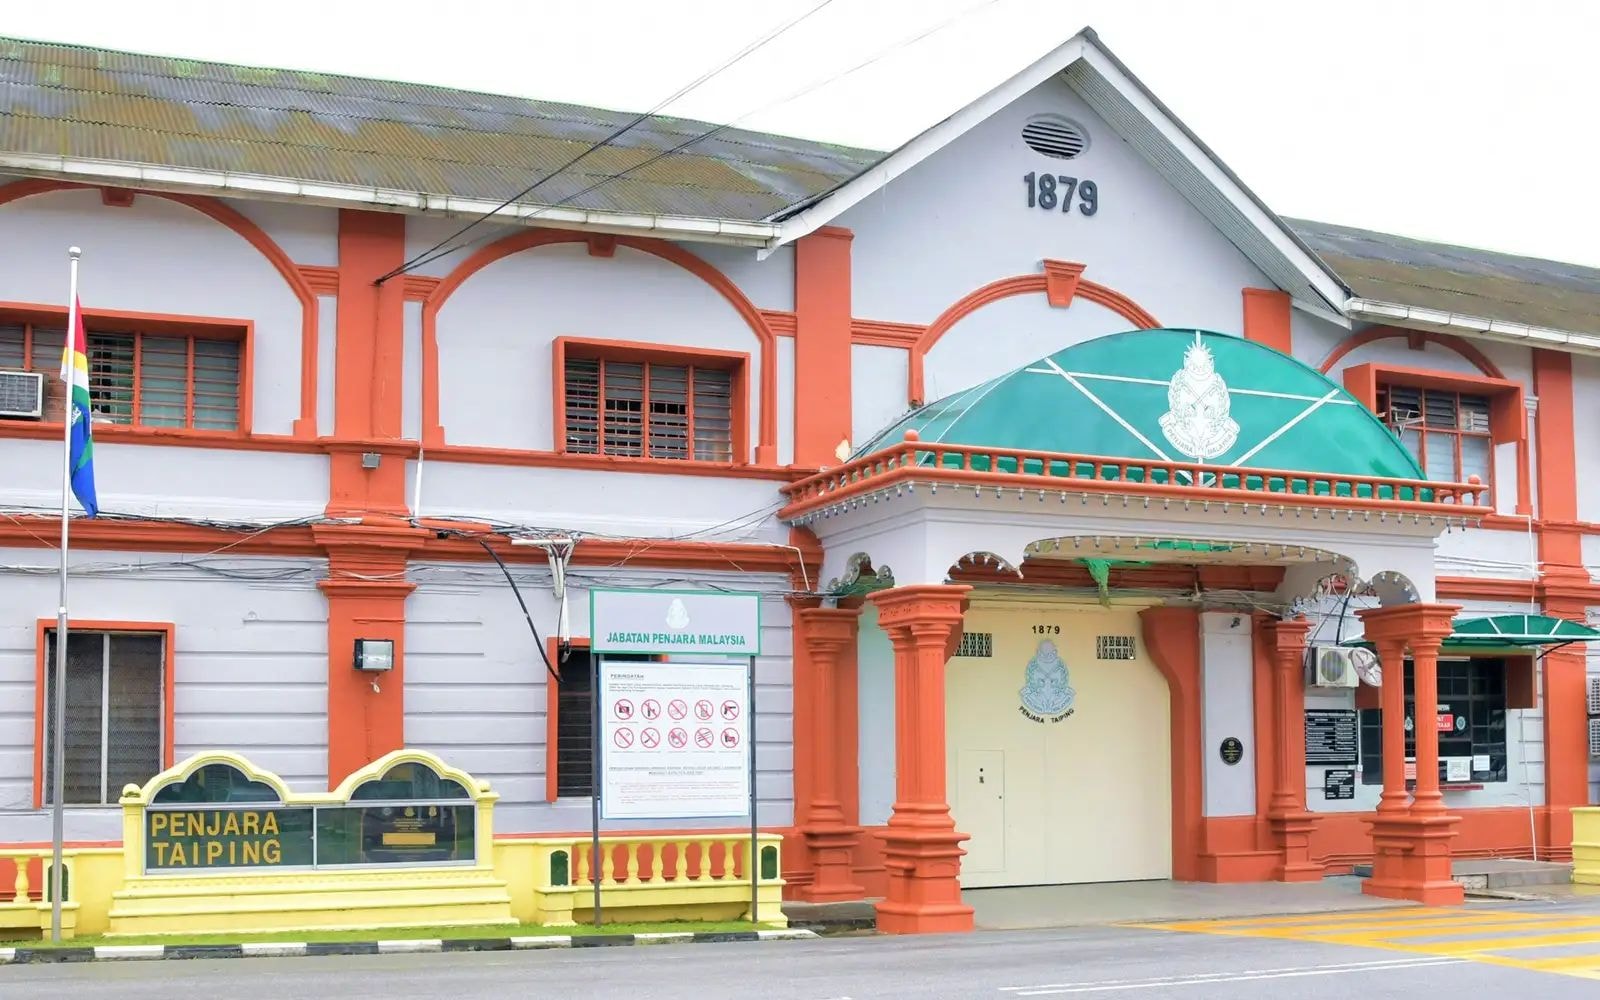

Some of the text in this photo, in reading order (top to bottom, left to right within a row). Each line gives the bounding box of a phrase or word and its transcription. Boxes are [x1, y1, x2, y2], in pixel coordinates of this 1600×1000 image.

[1024, 171, 1098, 217] 1879
[607, 632, 746, 646] JABATAN PENJARA MALAYSIA
[1032, 625, 1060, 635] 1879
[1019, 706, 1075, 724] PENJARA TAIPING
[151, 811, 280, 837] PENJARA
[152, 839, 281, 866] TAIPING
